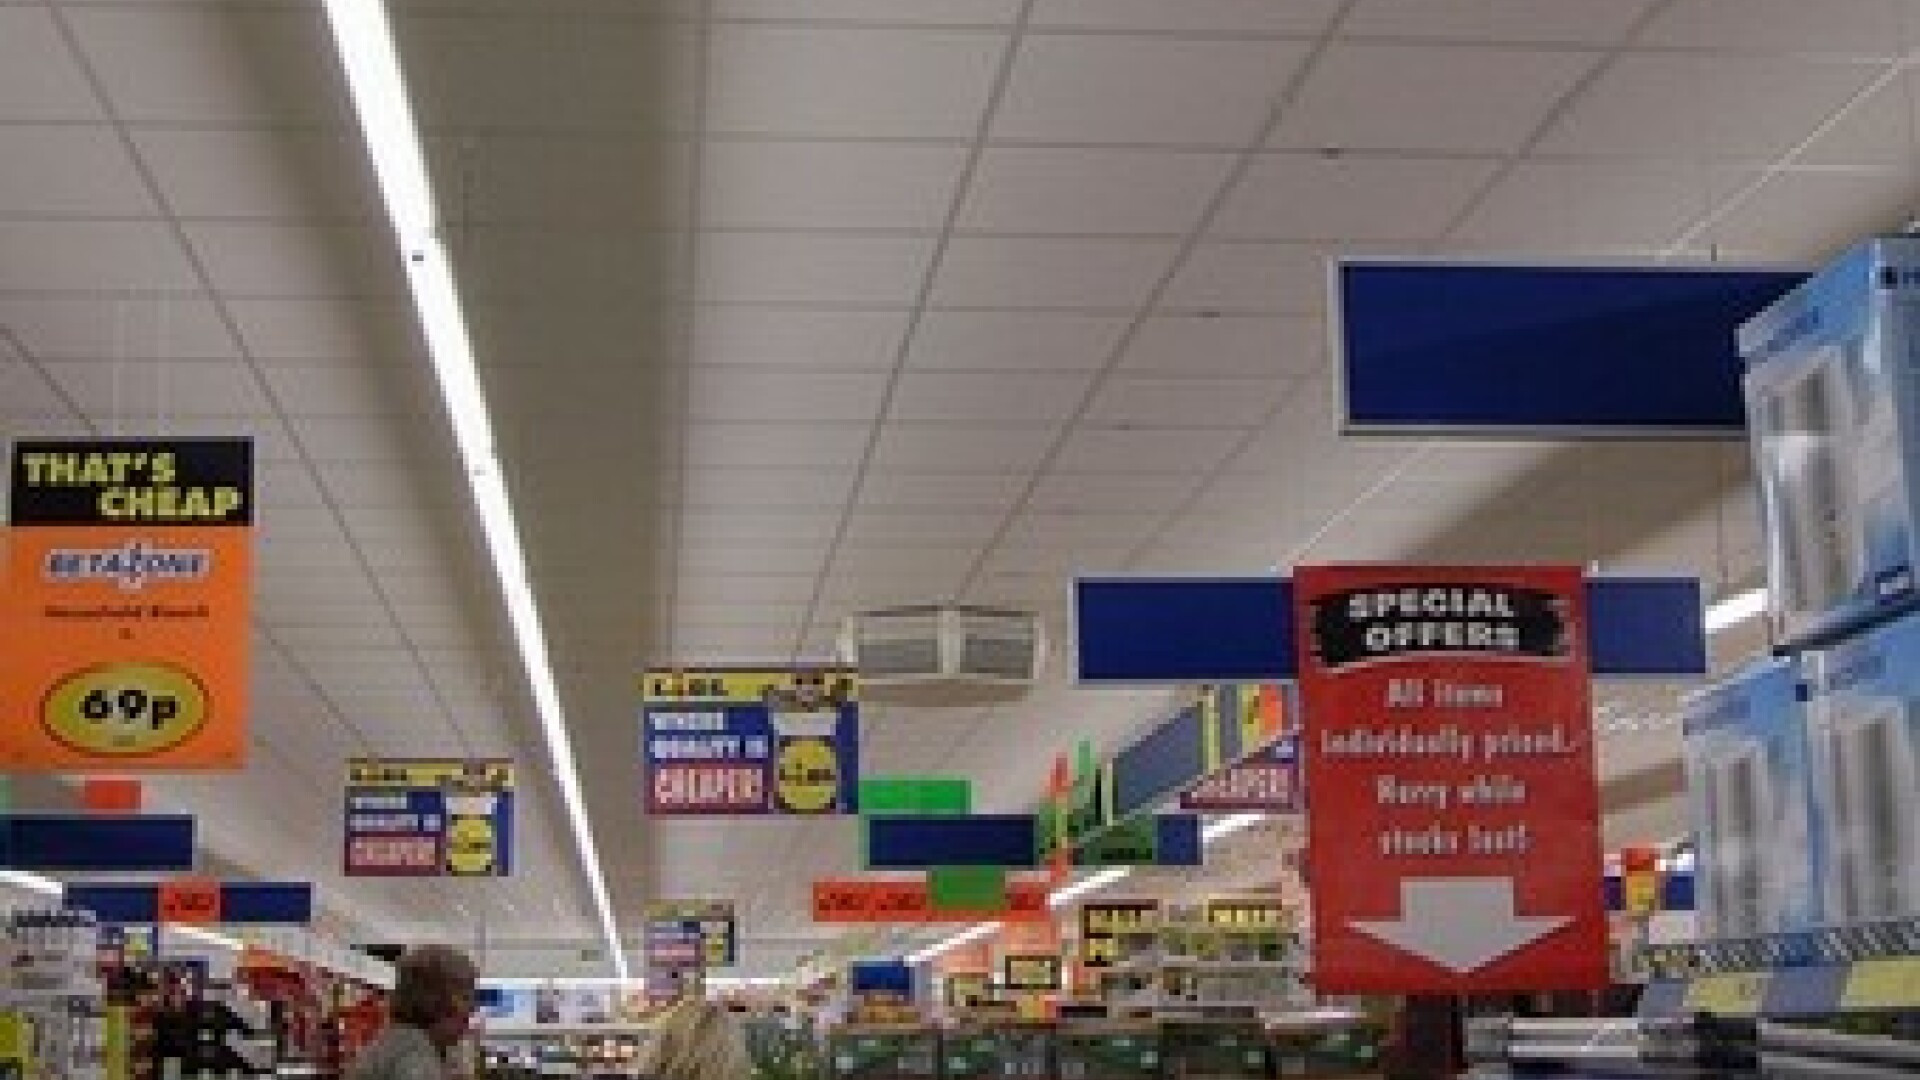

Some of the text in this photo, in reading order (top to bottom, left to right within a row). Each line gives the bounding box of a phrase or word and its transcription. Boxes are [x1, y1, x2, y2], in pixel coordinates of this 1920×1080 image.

[22, 452, 176, 485] THAT'S
[97, 486, 242, 518] CHEAP
[1347, 586, 1516, 620] SPECIAL
[1363, 622, 1520, 651] OFFERS
[81, 688, 179, 730] 69p
[1385, 677, 1504, 708] All items
[1376, 773, 1526, 809] Hurry while
[1379, 822, 1459, 856] stocks
